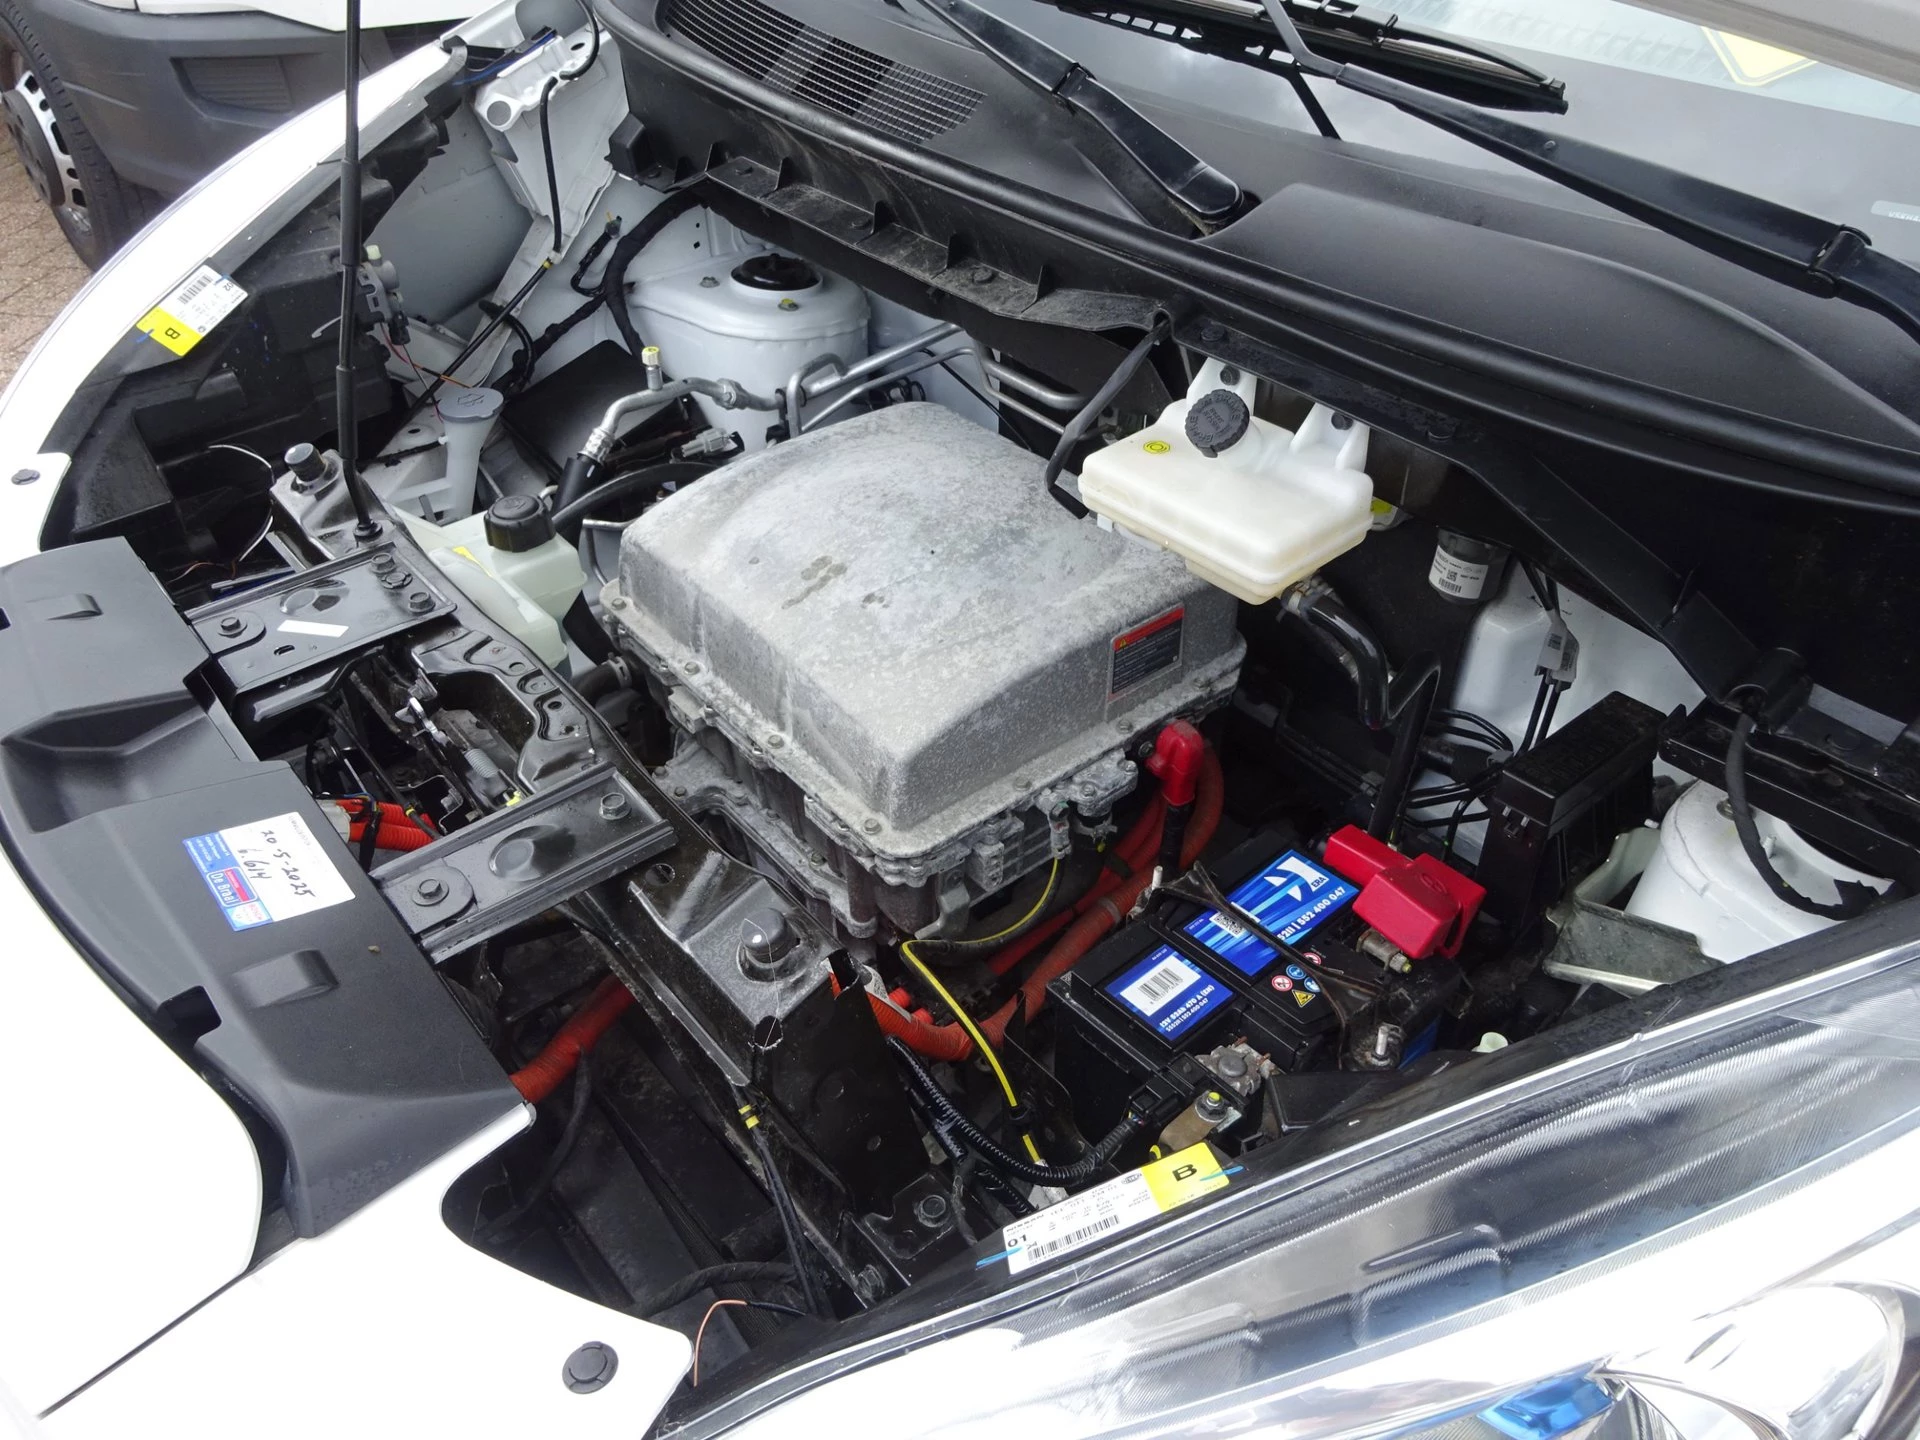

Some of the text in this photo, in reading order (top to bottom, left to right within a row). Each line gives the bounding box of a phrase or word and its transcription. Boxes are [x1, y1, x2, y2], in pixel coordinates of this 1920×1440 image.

[164, 327, 181, 340] B
[210, 872, 224, 885] De
[217, 882, 239, 904] Braal
[1310, 876, 1326, 888] ERA
[1297, 910, 1316, 926] 552
[1312, 899, 1331, 915] 400
[1328, 886, 1346, 900] 047
[1185, 998, 1198, 1012] 470
[1172, 1163, 1198, 1182] B
[1006, 1214, 1044, 1232] NISSAN
[1007, 1234, 1027, 1248] 01
